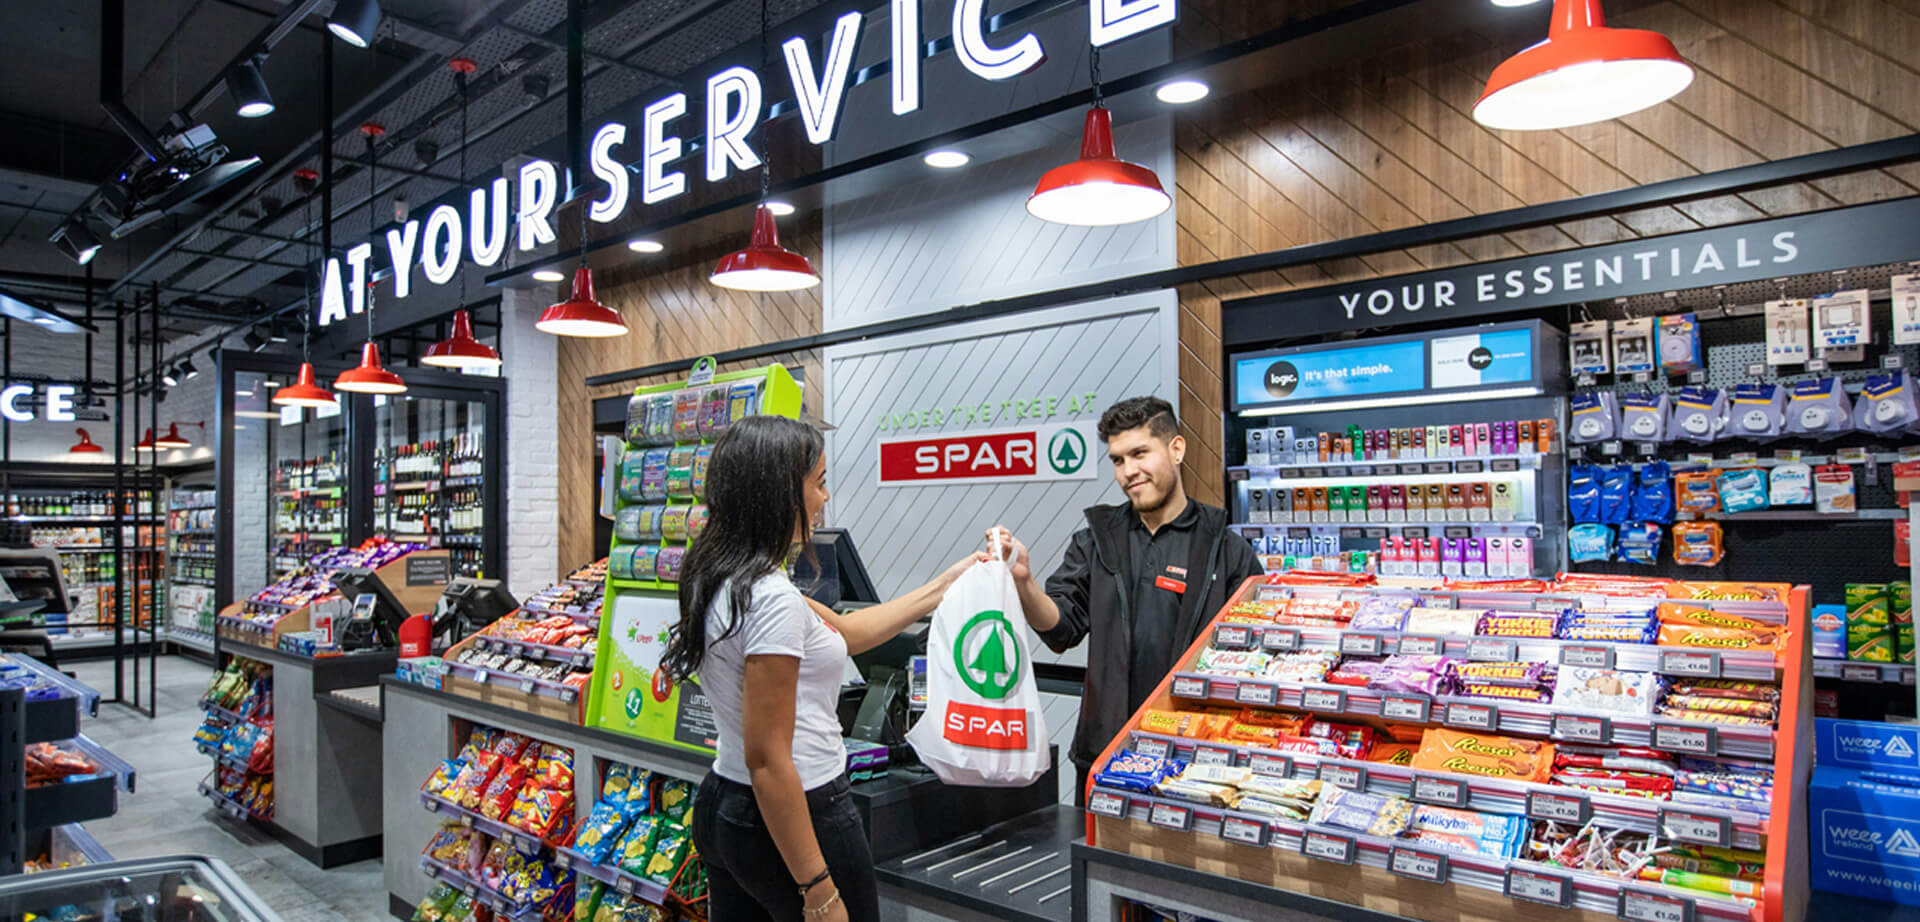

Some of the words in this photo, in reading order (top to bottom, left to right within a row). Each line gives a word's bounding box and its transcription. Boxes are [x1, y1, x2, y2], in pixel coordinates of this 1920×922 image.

[319, 243, 371, 326] AT
[387, 161, 557, 298] YOUR
[589, 0, 1178, 223] SERVIC
[1338, 280, 1457, 320] YOUR
[1476, 231, 1800, 300] ESSENTIALS
[1305, 370, 1323, 381] It's
[1325, 367, 1347, 378] that
[1351, 362, 1393, 377] simple.
[0, 386, 75, 422] CE
[878, 408, 944, 431] UNDER
[952, 404, 992, 424] THE
[1001, 396, 1058, 421] TREE
[1068, 392, 1097, 415] AT
[915, 439, 1034, 474] SPAR
[1681, 632, 1750, 648] Reese's
[1455, 665, 1525, 679] YORKIE
[947, 712, 1025, 737] SPAR
[1839, 736, 1882, 749] weee
[1829, 826, 1883, 845] weee
[1833, 838, 1874, 851] ireland
